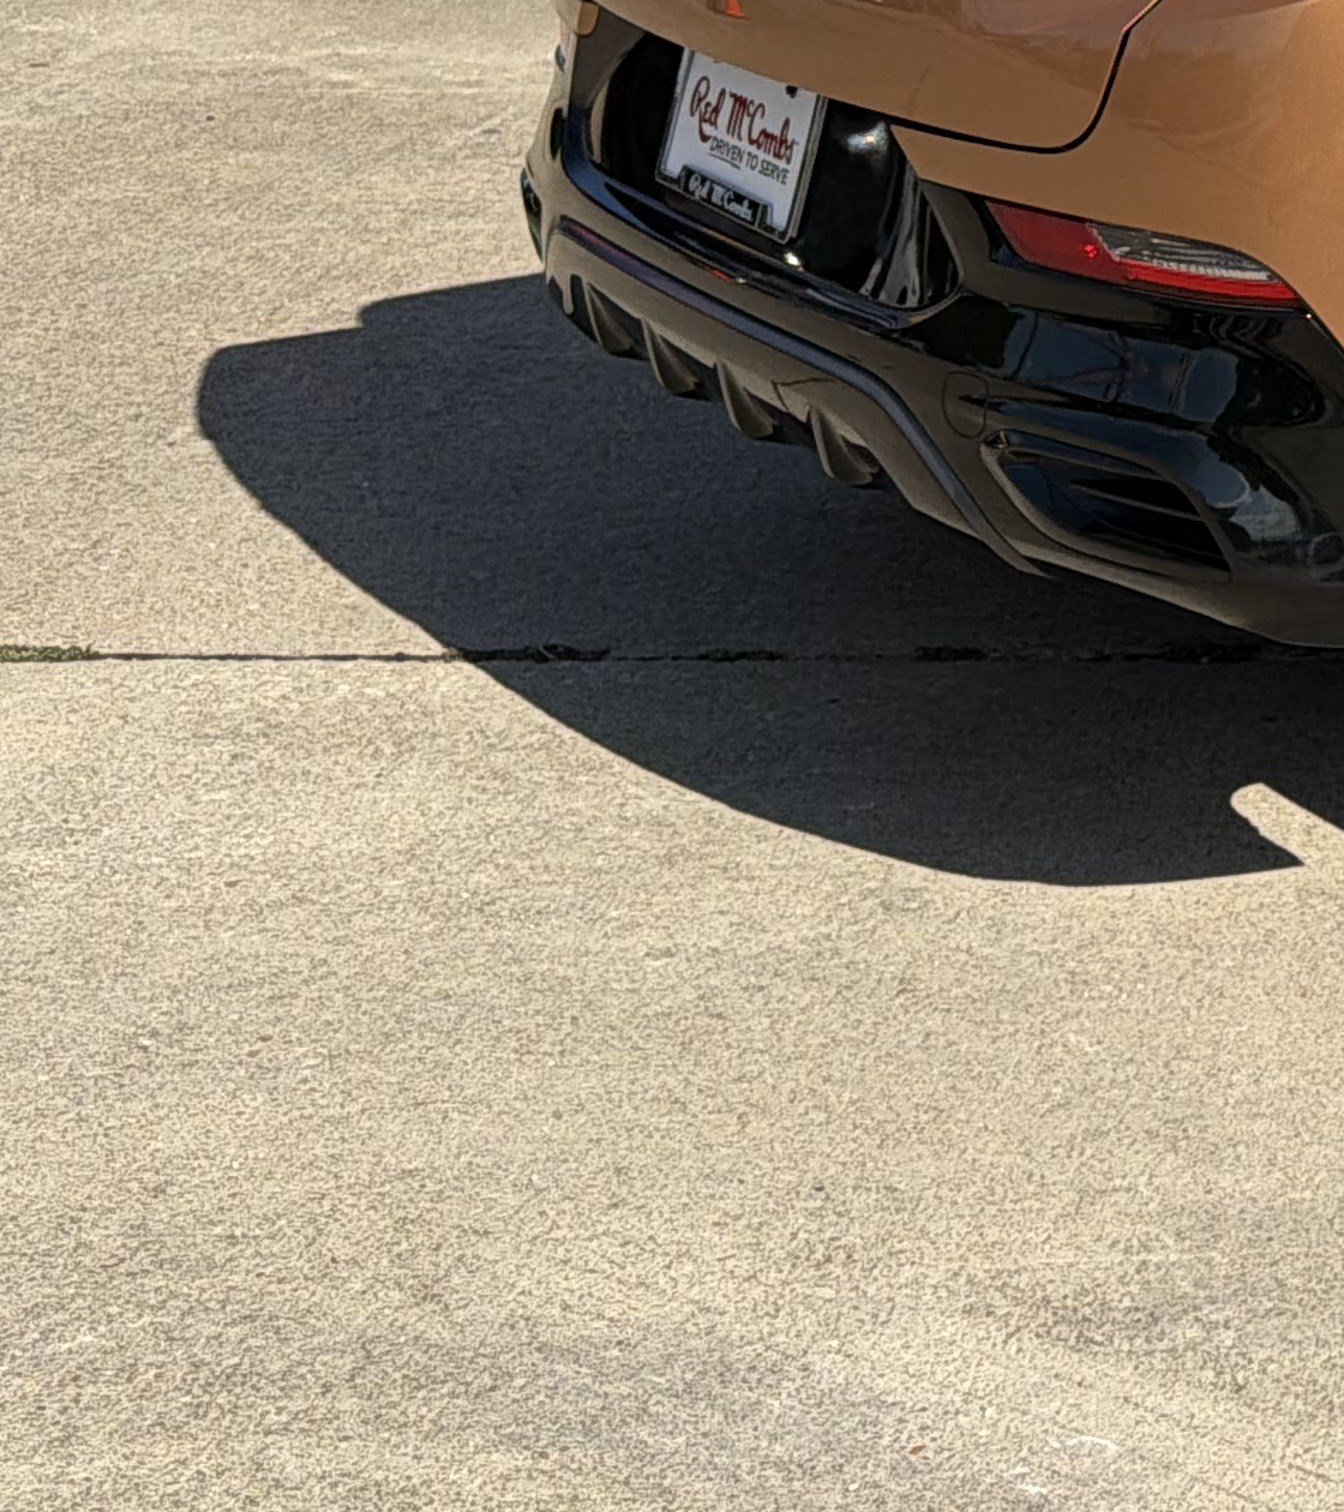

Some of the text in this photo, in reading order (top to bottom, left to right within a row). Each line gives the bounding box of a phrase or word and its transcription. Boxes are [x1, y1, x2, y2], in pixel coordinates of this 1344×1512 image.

[689, 75, 726, 143] Red
[709, 136, 790, 186] DRIVEN TO SERVE
